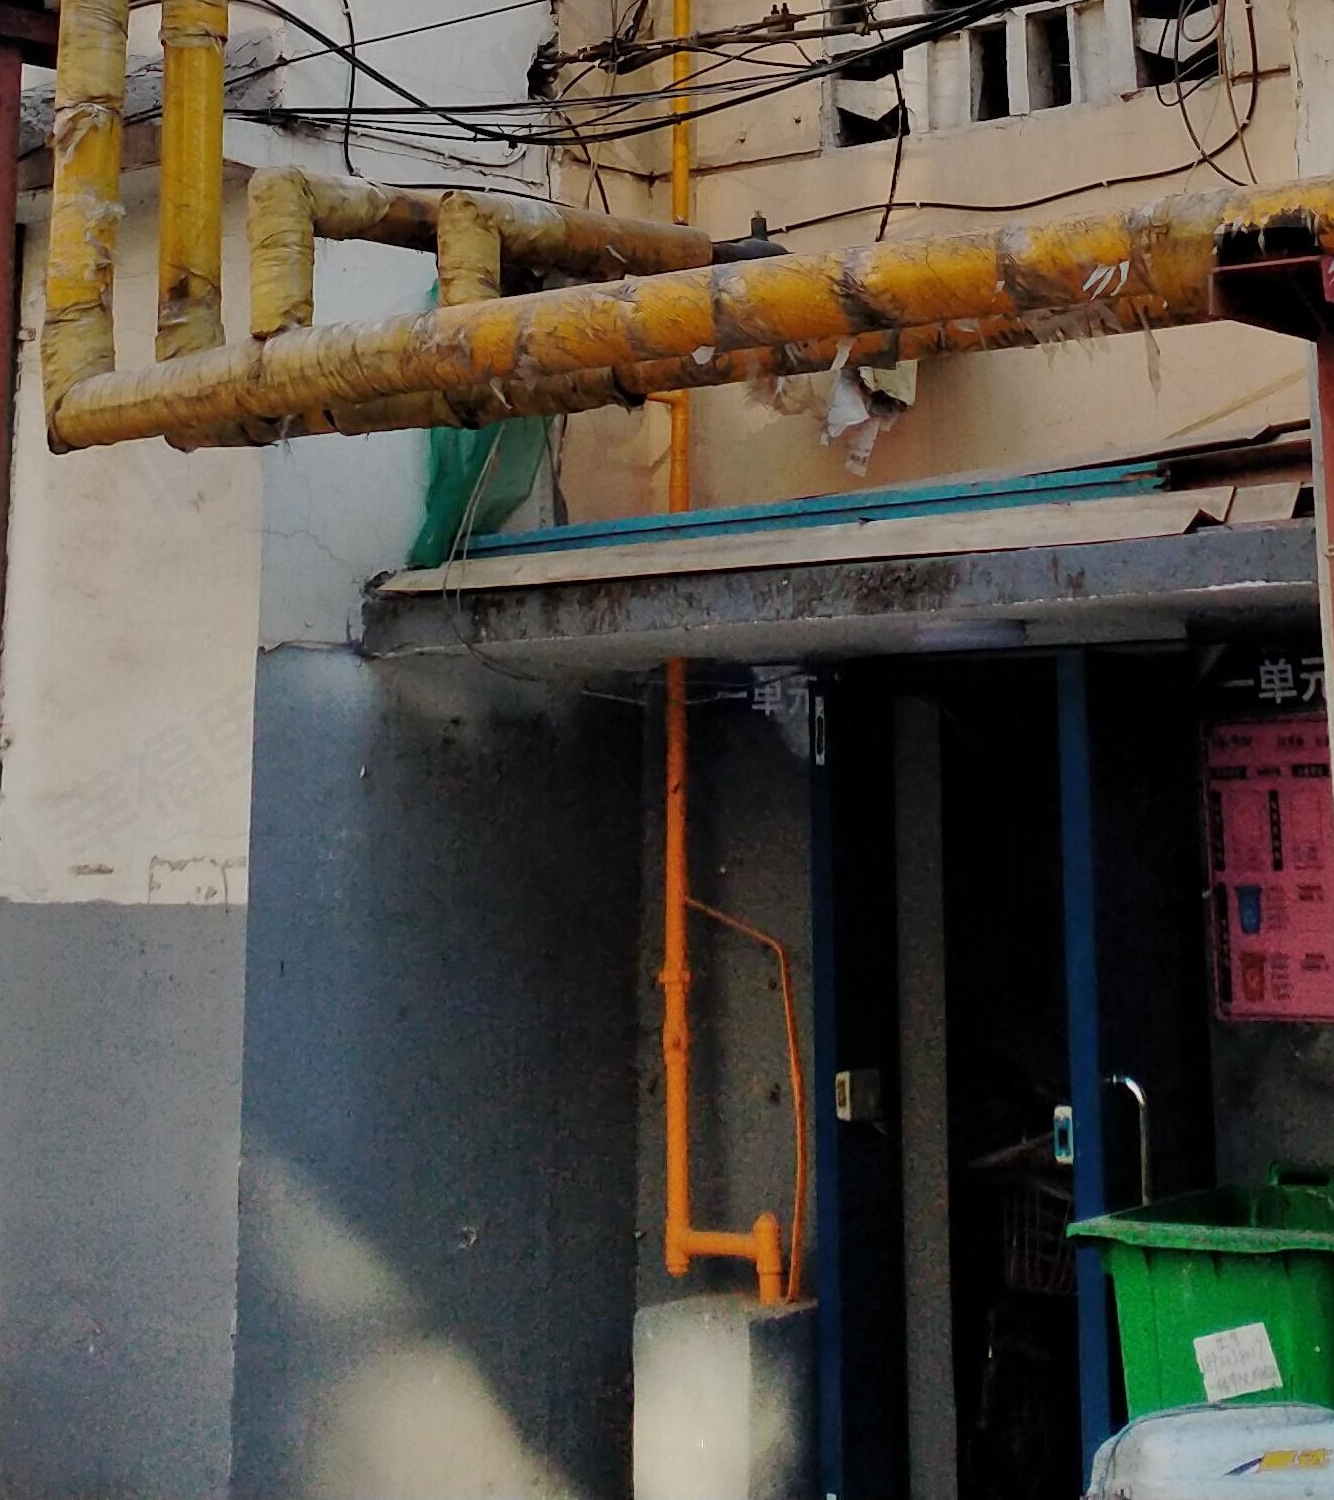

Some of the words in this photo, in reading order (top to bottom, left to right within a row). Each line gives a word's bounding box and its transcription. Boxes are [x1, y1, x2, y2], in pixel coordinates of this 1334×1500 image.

[717, 674, 818, 717] 一单元
[1218, 656, 1326, 705] 一单元
